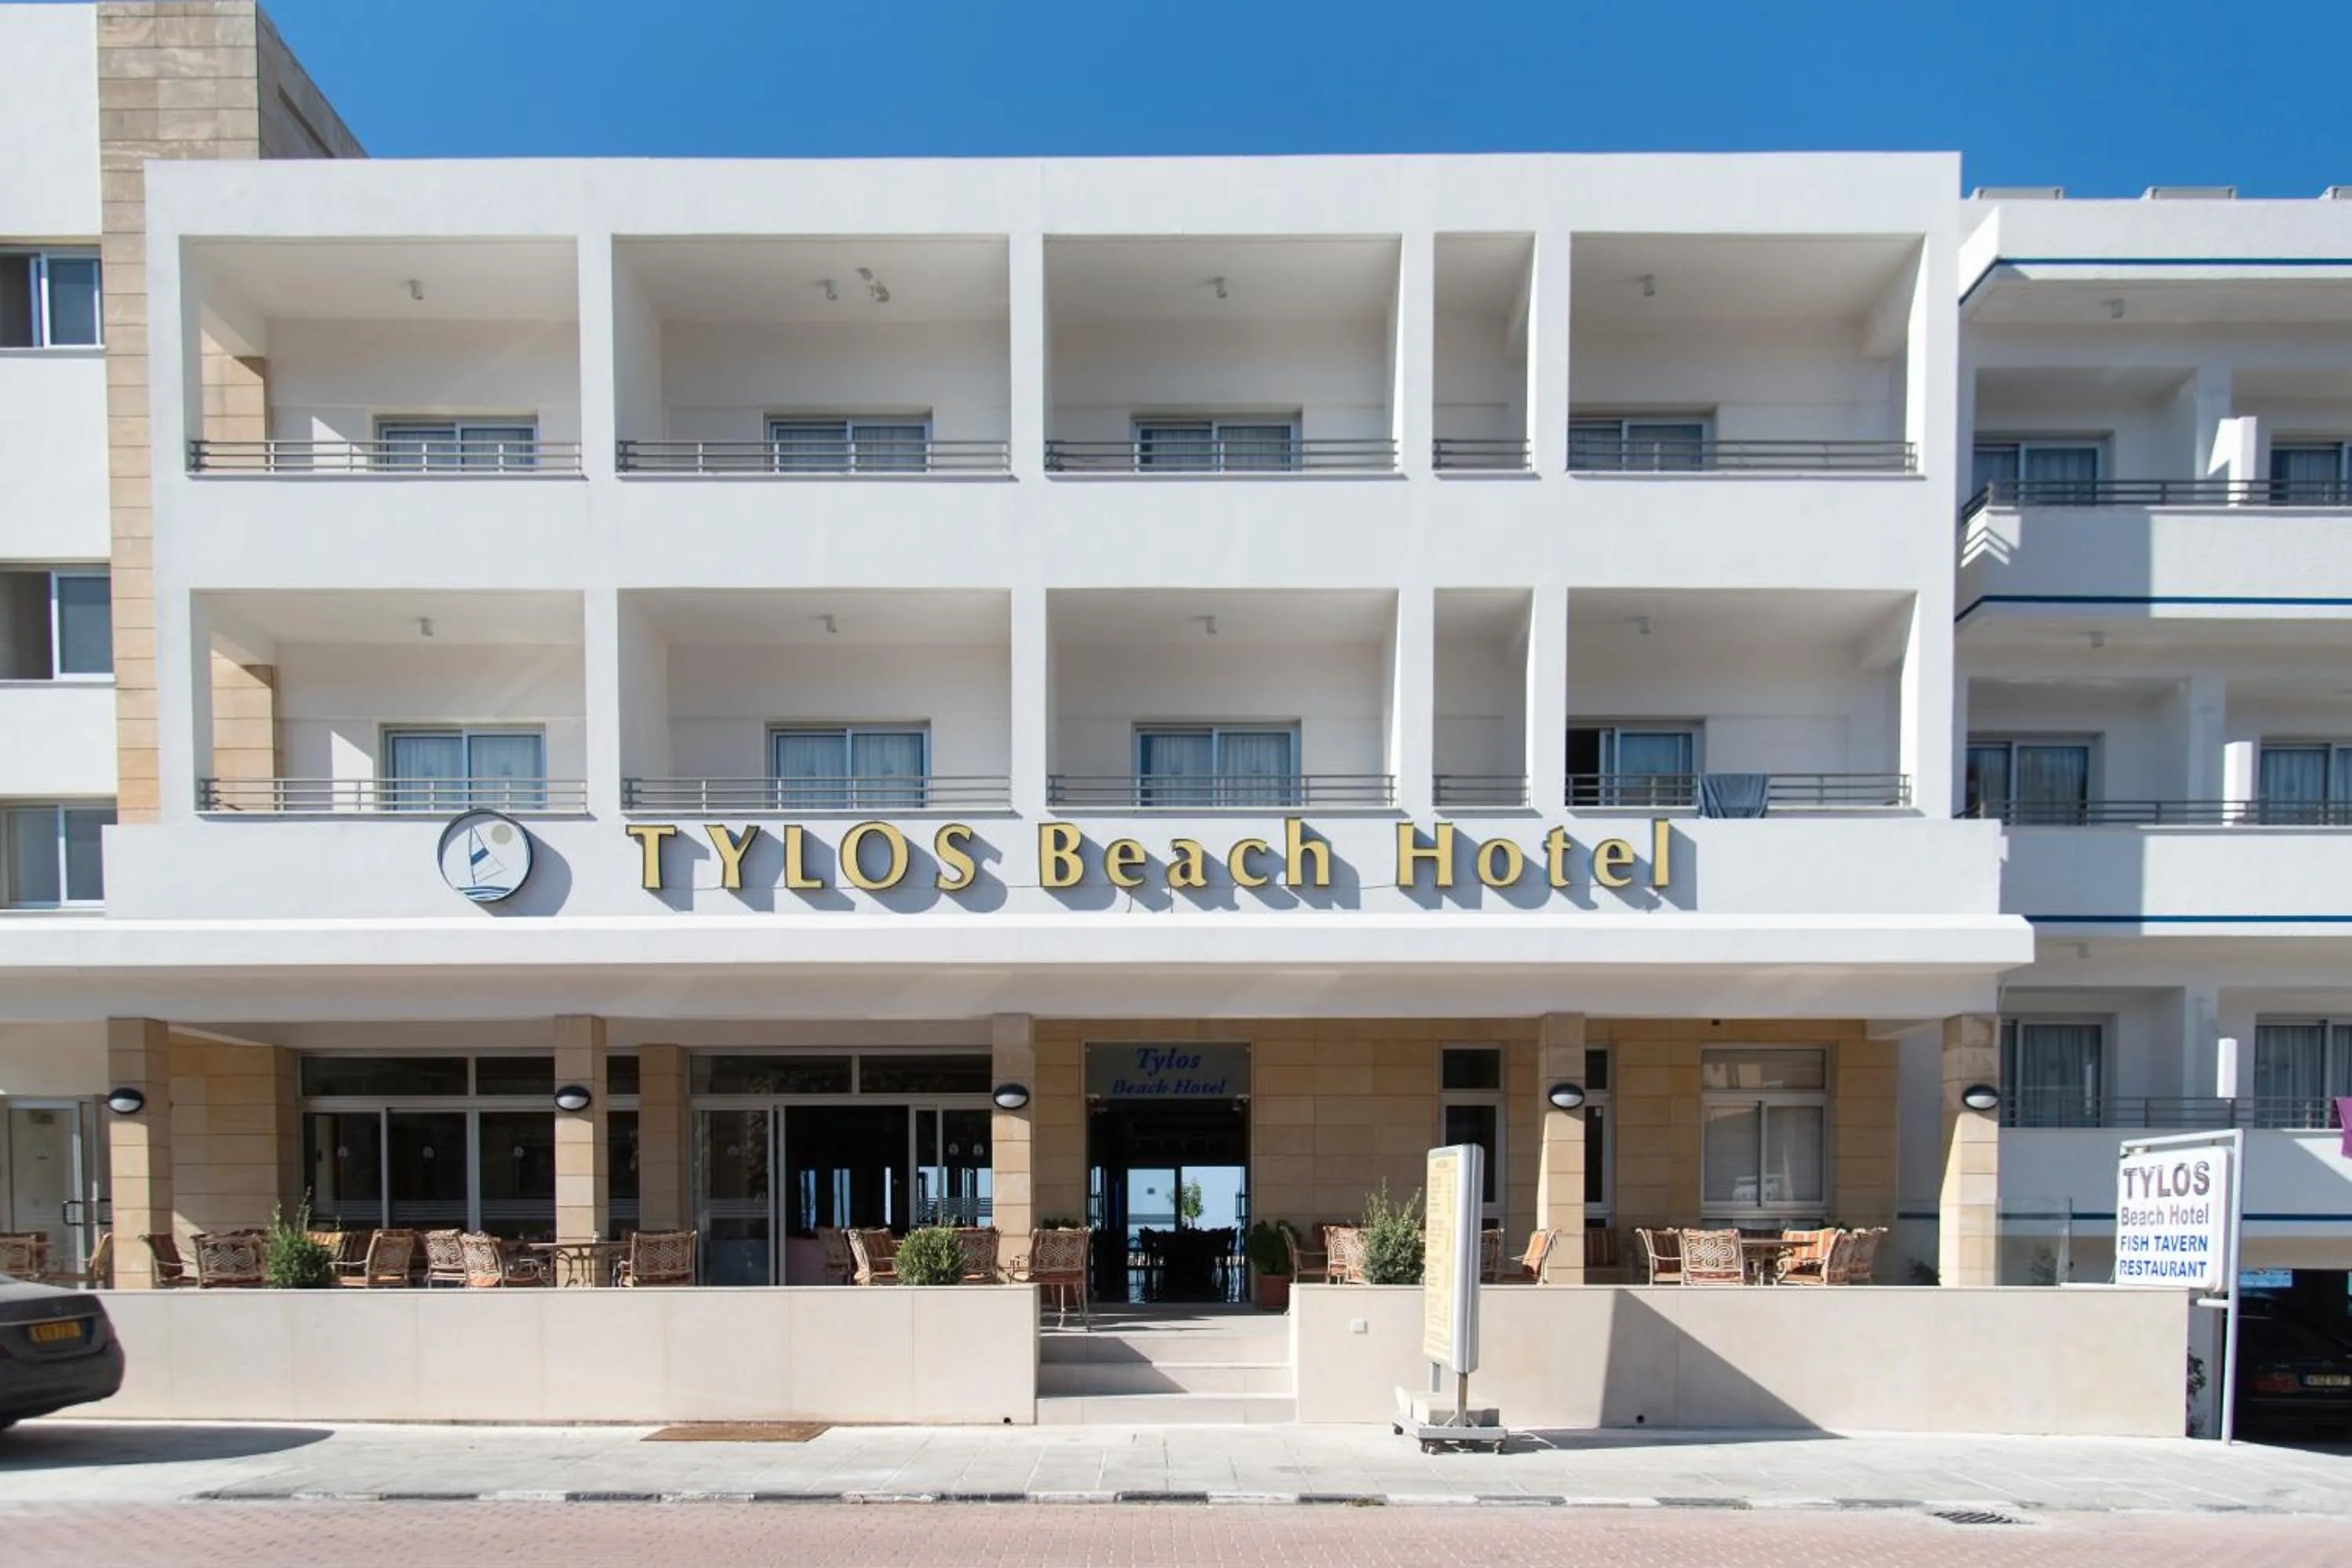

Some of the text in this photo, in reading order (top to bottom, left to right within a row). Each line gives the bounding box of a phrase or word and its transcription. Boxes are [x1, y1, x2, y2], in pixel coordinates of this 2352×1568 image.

[626, 817, 1670, 891] TYLOS Beach Hotel
[1136, 1047, 1201, 1076] Tylos
[1112, 1079, 1226, 1094] Beach Hotel
[2122, 1160, 2211, 1200] TYLOS
[2121, 1202, 2209, 1226] Beach Hotel
[2120, 1235, 2209, 1253] FISH TAVERN
[2119, 1259, 2208, 1278] RESTAURANT
